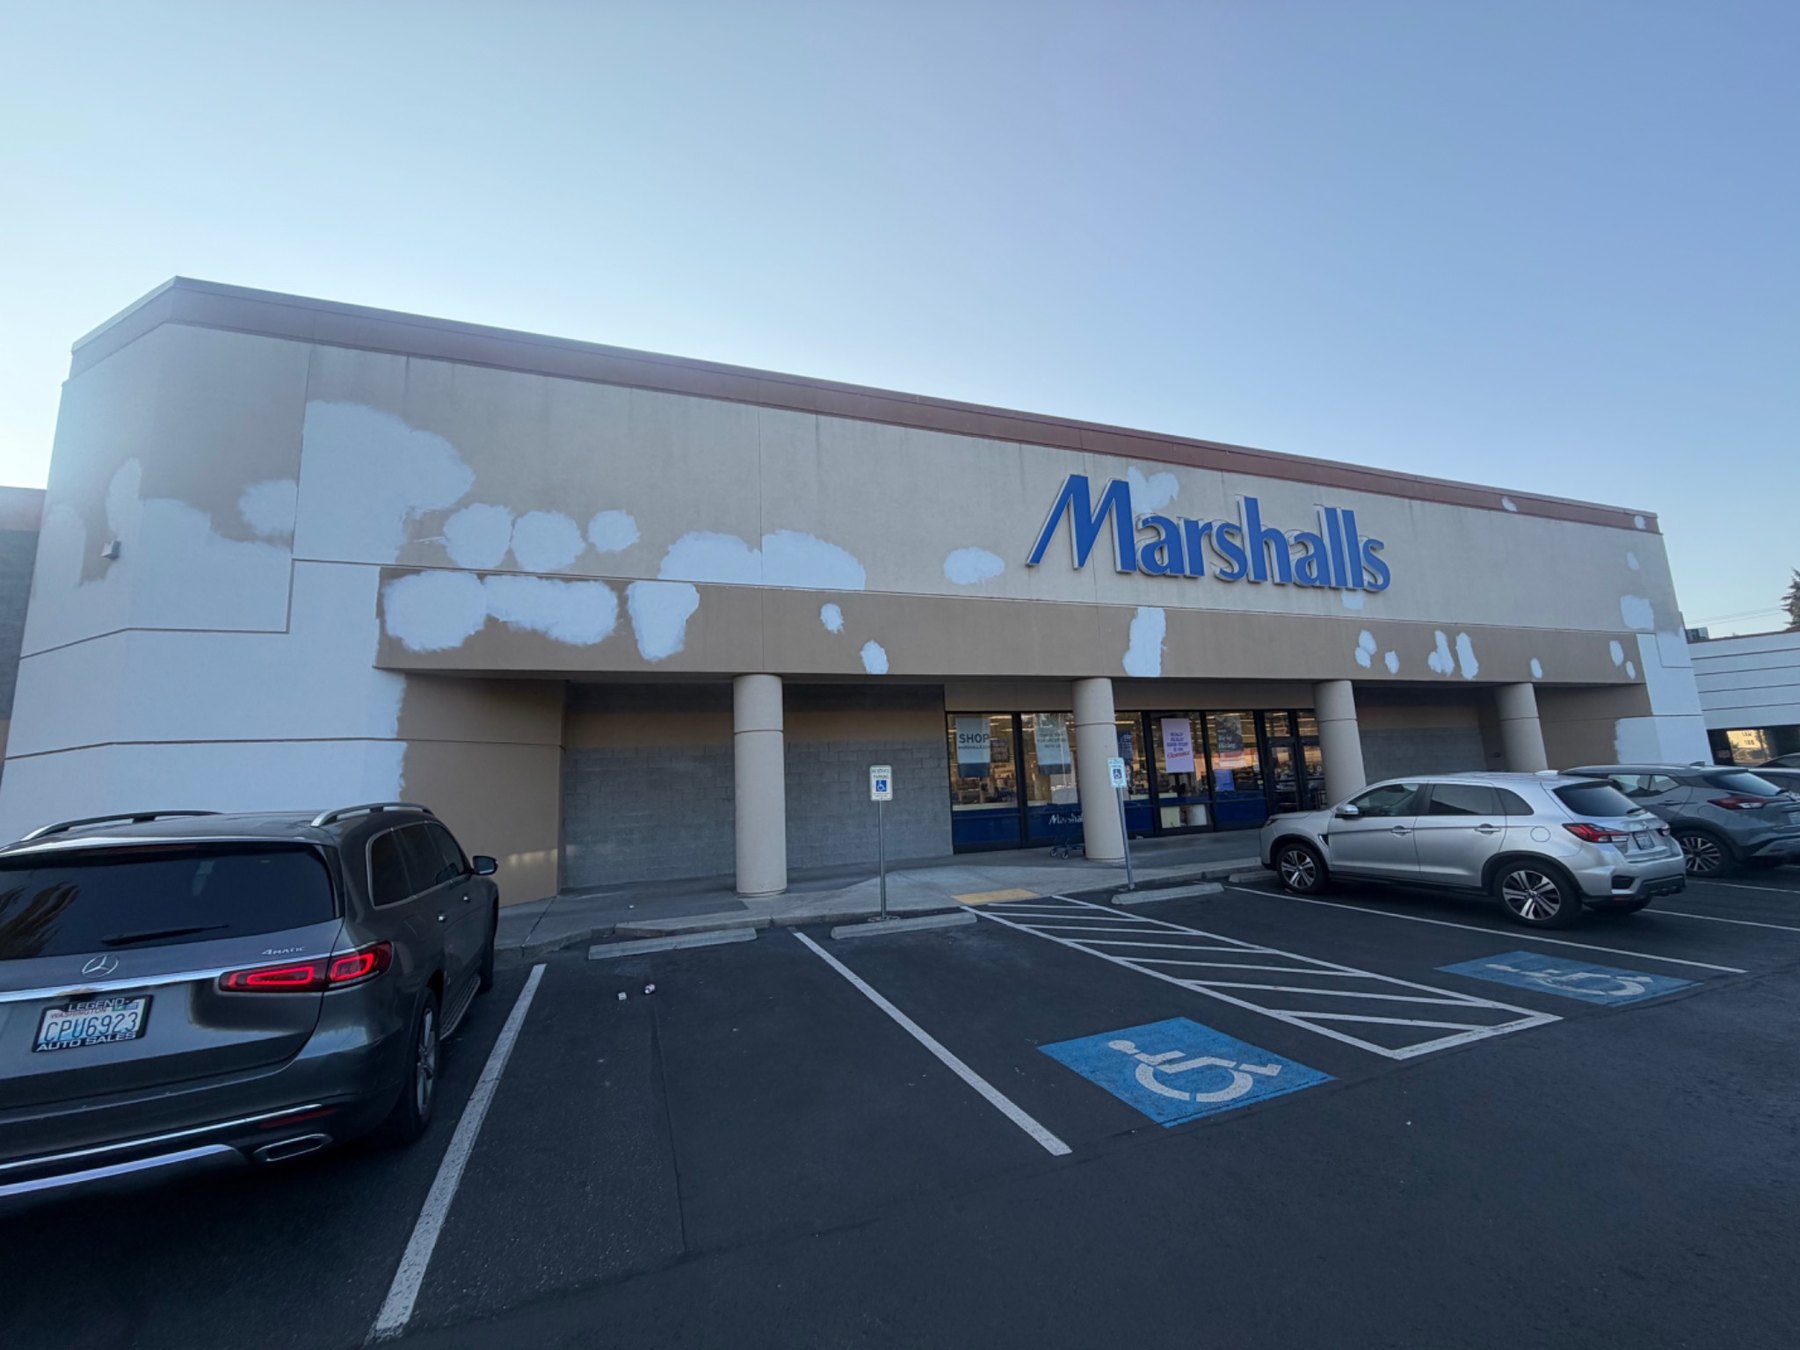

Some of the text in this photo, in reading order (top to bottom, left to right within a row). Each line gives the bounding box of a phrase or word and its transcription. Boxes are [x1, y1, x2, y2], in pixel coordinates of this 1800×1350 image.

[1026, 474, 1391, 592] Marshalls
[958, 733, 990, 744] SHOP
[68, 998, 125, 1012] LEGEND
[43, 1011, 138, 1043] CPU6923
[36, 1031, 136, 1052] AUTO SALES
